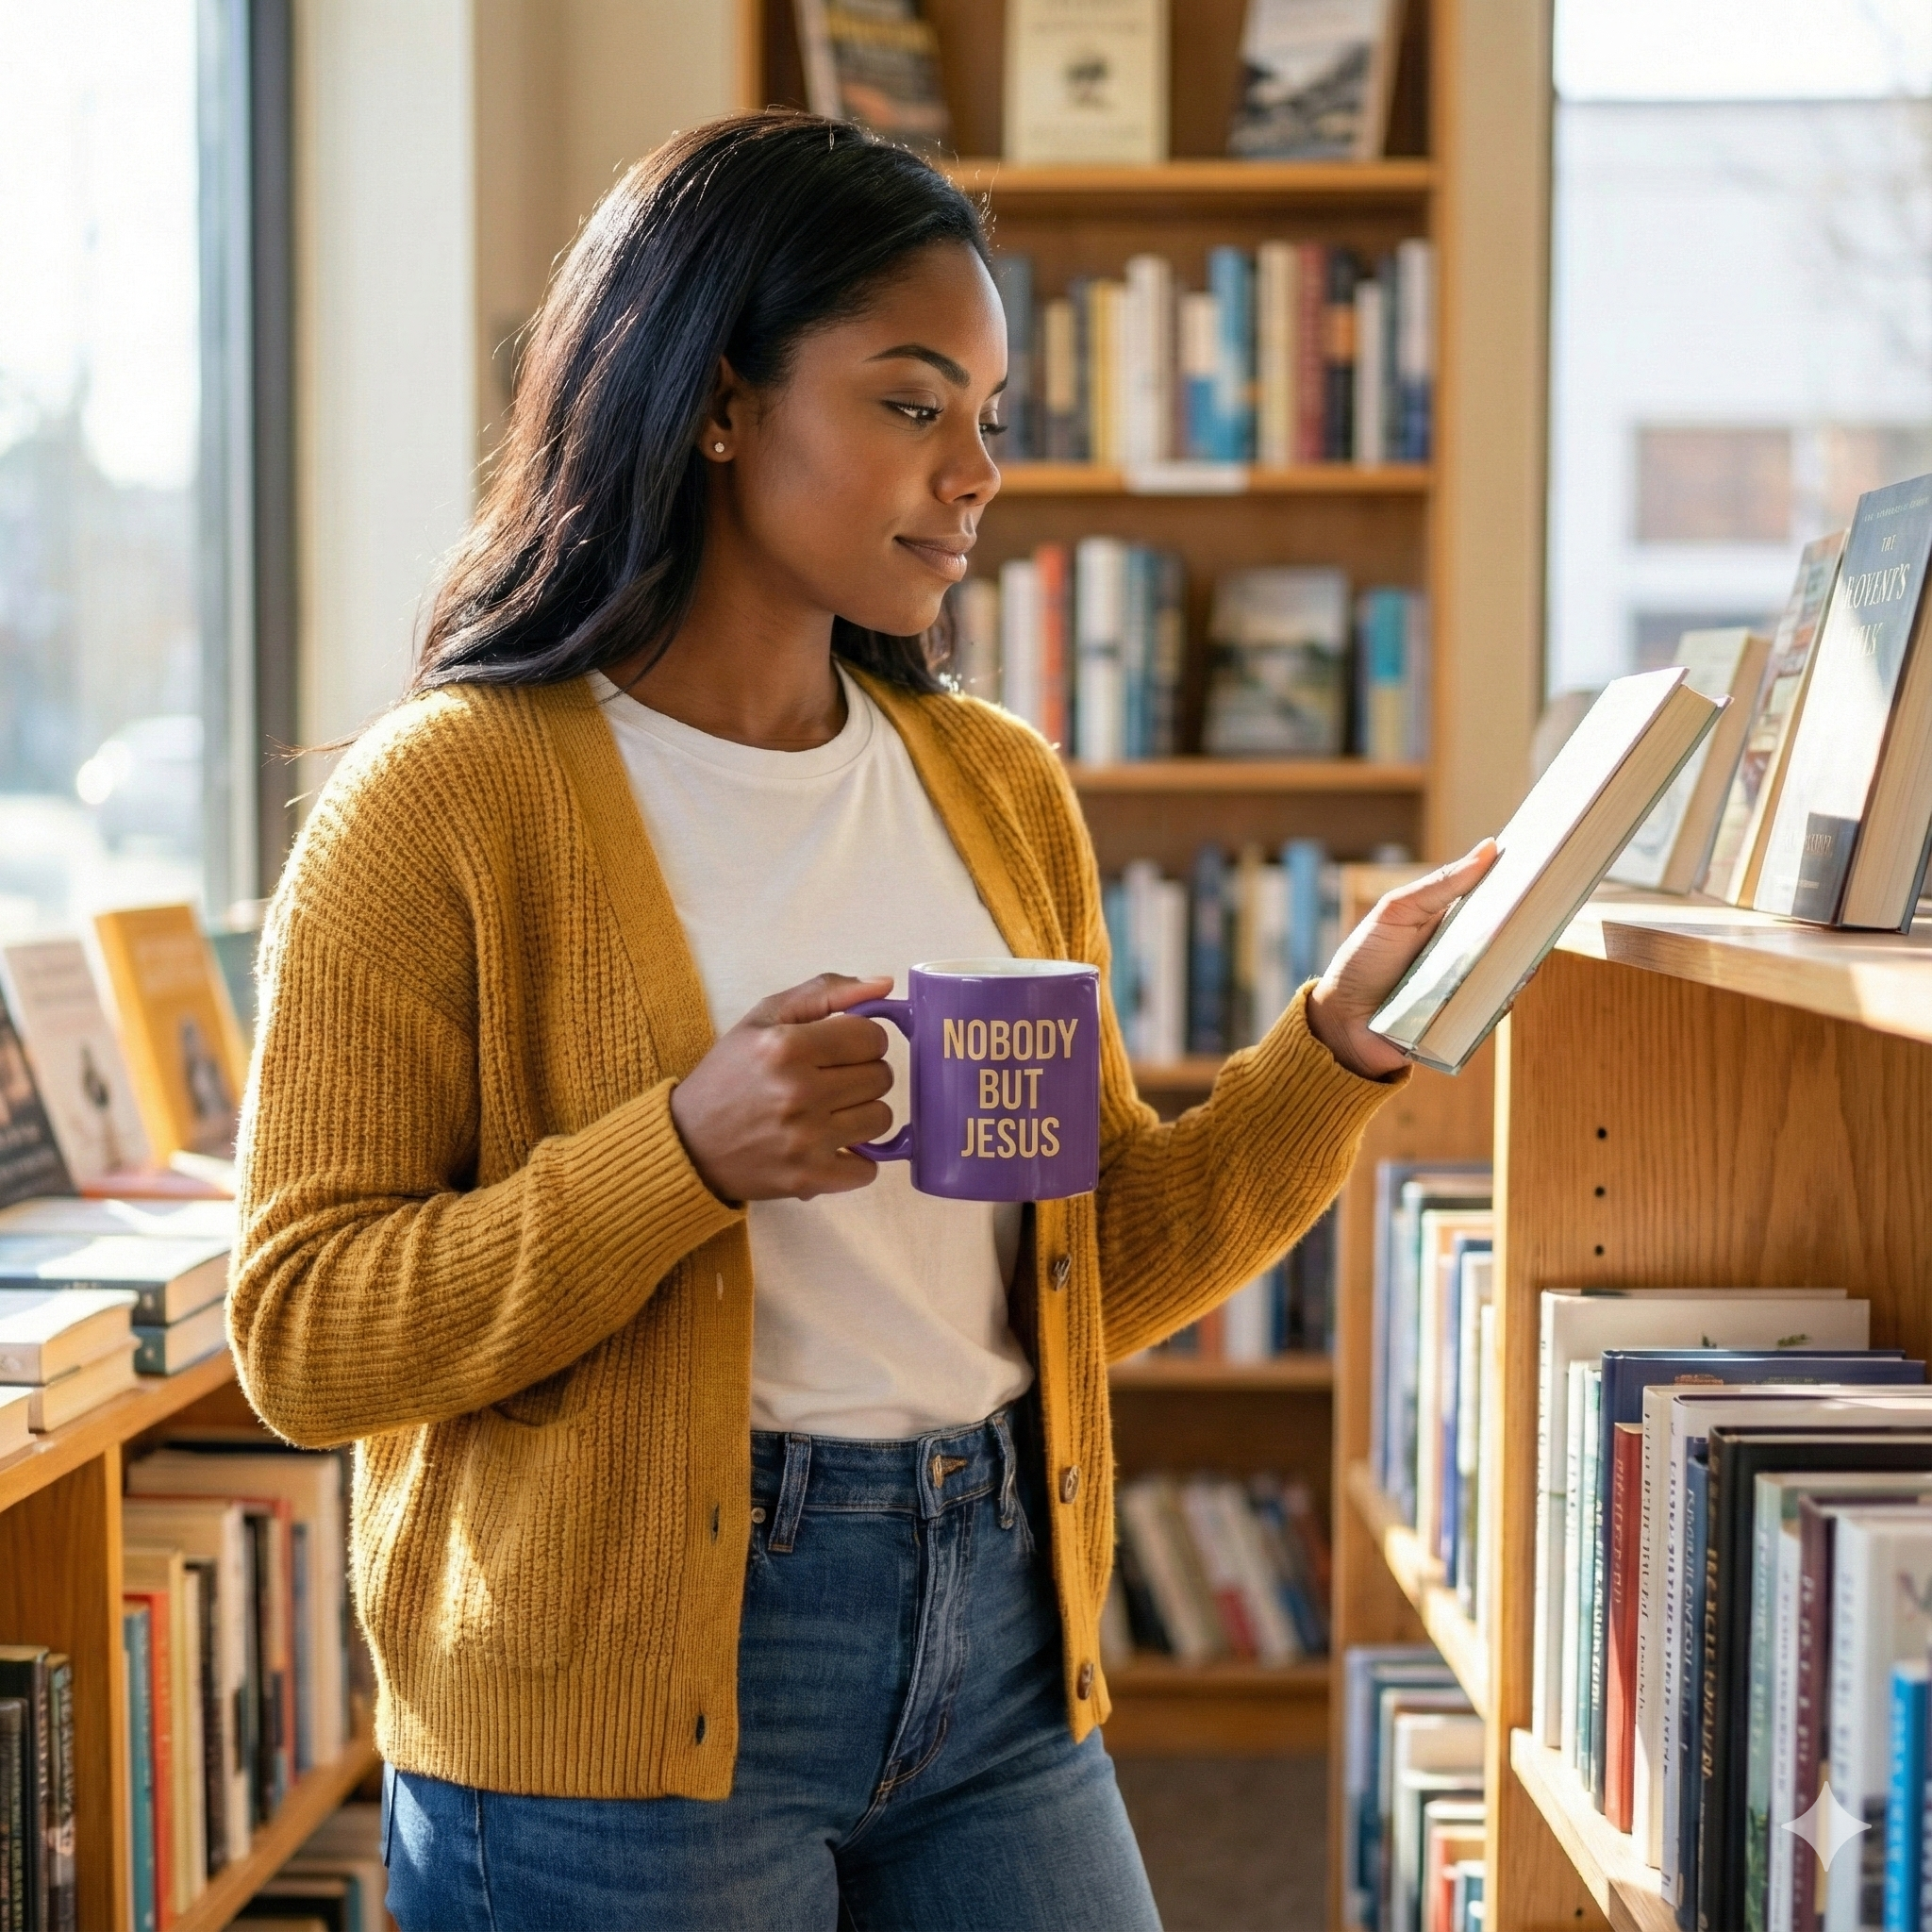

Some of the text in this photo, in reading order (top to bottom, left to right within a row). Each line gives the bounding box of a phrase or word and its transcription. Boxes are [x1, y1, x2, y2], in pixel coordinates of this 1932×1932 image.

[943, 1019, 1078, 1060] NOBODY
[979, 1069, 1043, 1109] BUT
[961, 1117, 1060, 1158] JESUS
